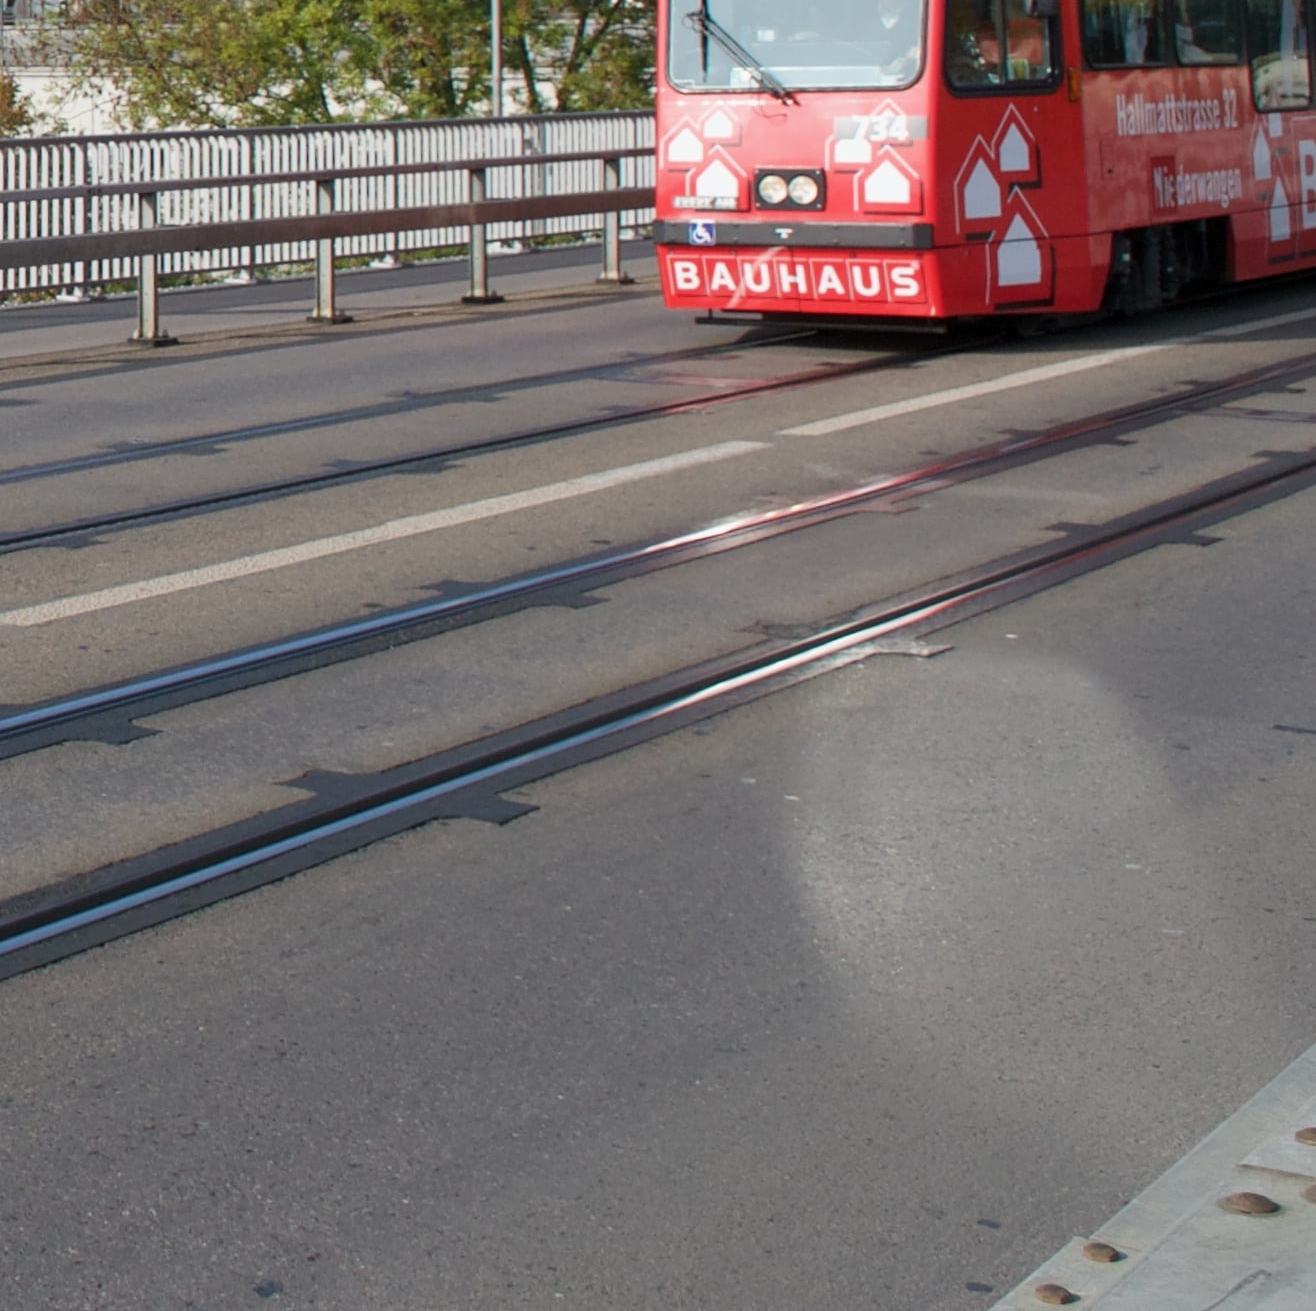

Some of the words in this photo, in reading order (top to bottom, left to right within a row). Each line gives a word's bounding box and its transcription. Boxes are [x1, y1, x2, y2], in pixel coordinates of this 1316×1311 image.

[851, 115, 909, 141] 734
[1116, 93, 1221, 136] Hallmattstrasse
[1222, 88, 1239, 129] 32
[1153, 164, 1242, 208] Niederwangen
[673, 260, 920, 297] BAUHAUS
